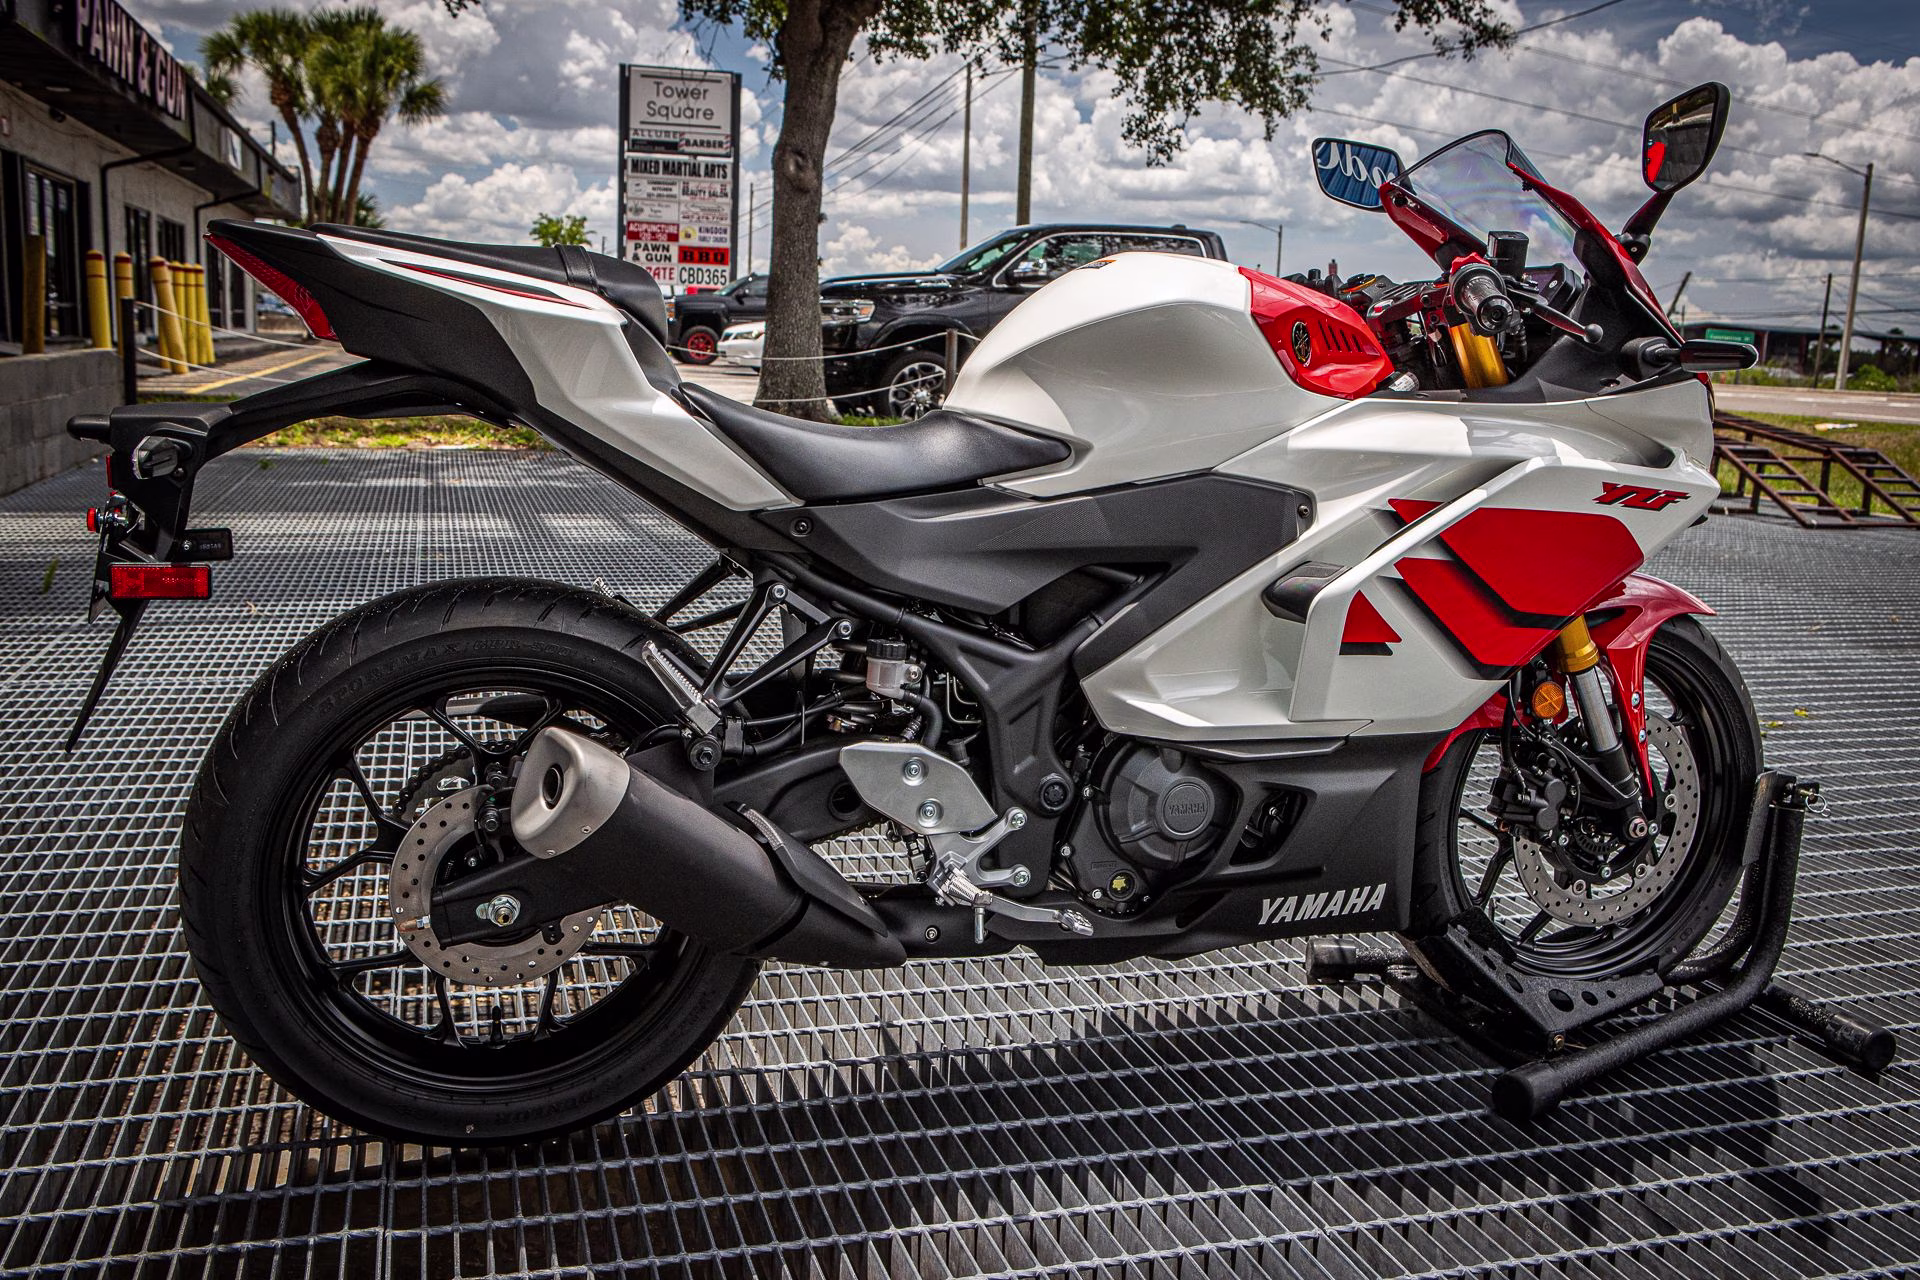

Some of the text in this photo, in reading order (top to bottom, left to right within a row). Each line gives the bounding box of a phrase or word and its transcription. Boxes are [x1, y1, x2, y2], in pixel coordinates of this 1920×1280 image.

[76, 0, 186, 121] PAWN & GUN
[653, 81, 709, 100] Tower
[646, 100, 714, 121] Square
[685, 139, 724, 149] BARBER
[631, 159, 728, 179] MIXED MARTIAL ARTS
[682, 186, 706, 196] BEAUTY
[629, 222, 678, 234] ACUPUNCTURE
[698, 226, 728, 235] KINGDOM
[634, 242, 670, 253] PAWN
[631, 252, 672, 263] & GUN
[682, 249, 726, 263] BBQ
[679, 266, 728, 286] CBD365
[1168, 802, 1205, 815] YAMAHA
[1258, 882, 1387, 925] YAMAHA
